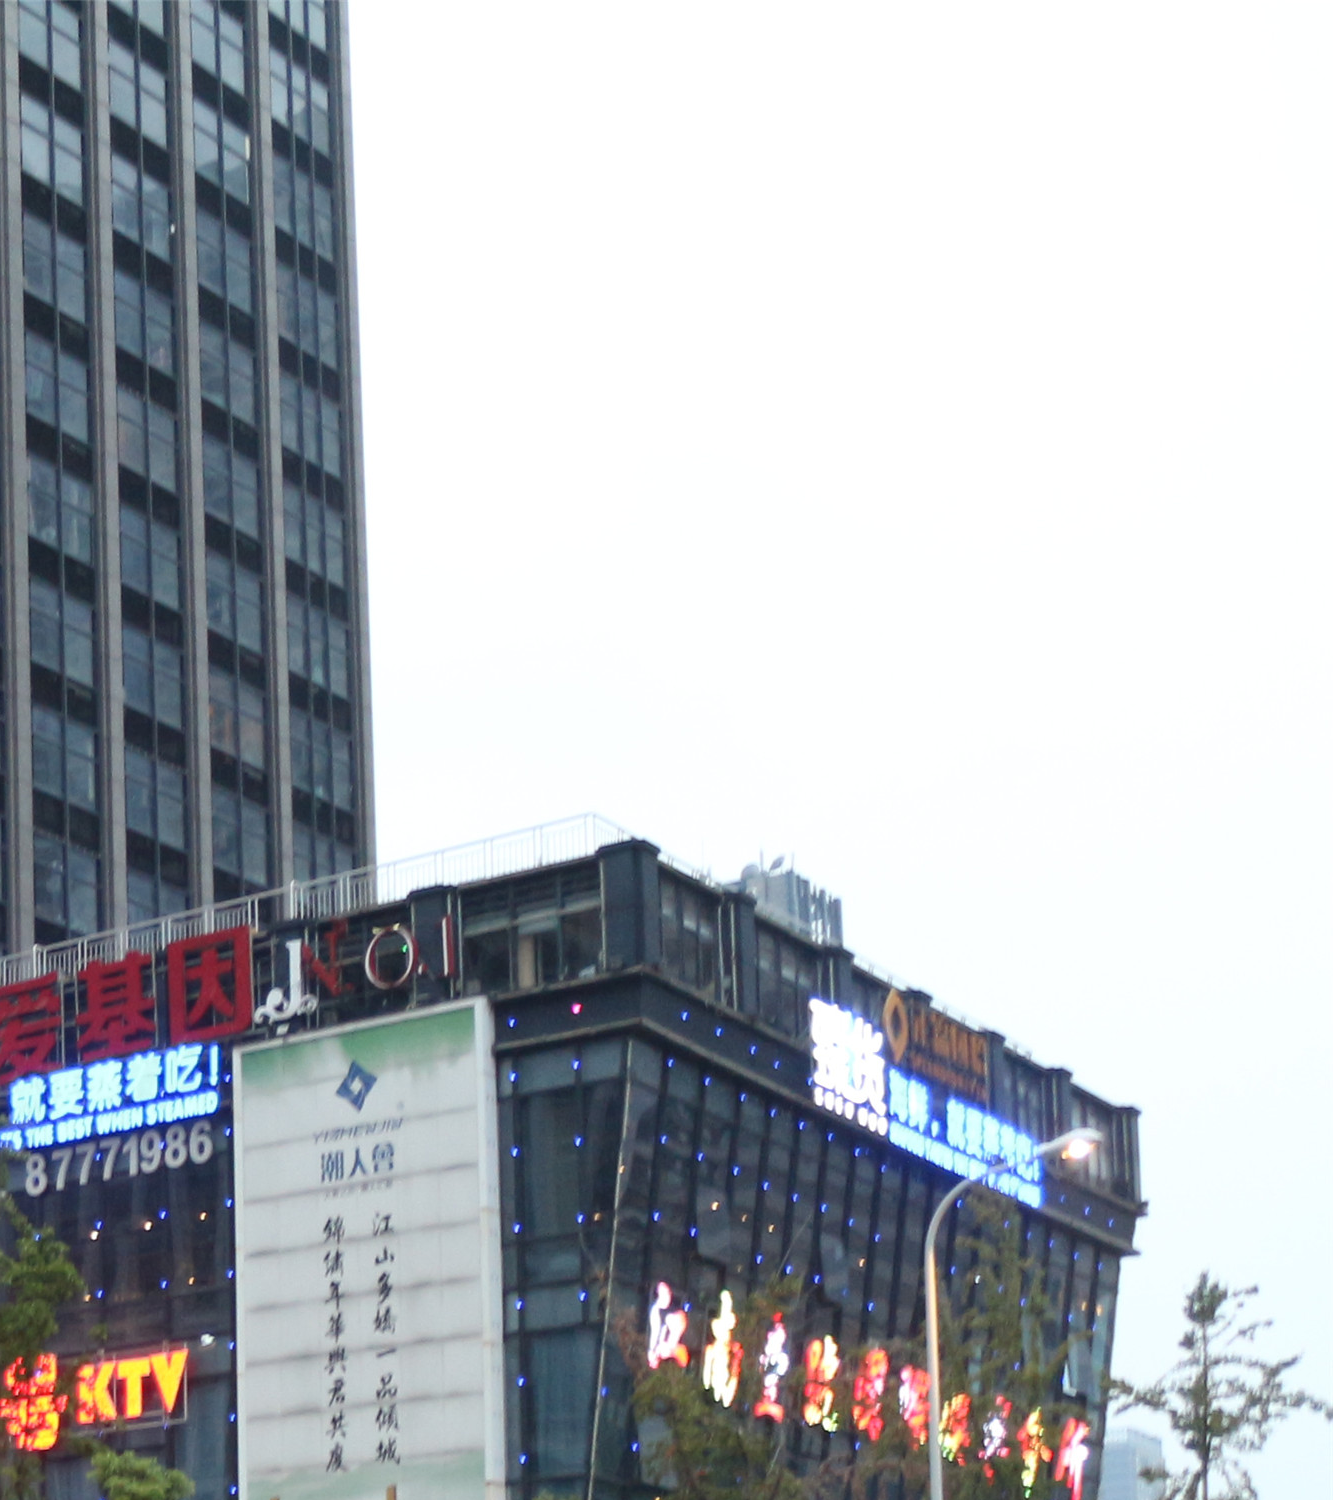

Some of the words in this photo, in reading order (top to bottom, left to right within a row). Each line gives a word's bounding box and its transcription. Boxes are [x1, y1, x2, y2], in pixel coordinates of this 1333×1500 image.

[24, 1124, 55, 1149] THE
[56, 1115, 94, 1142] BEST
[95, 1105, 144, 1135] WHEN
[145, 1091, 220, 1126] STEAMED
[24, 1120, 214, 1197] 87771986
